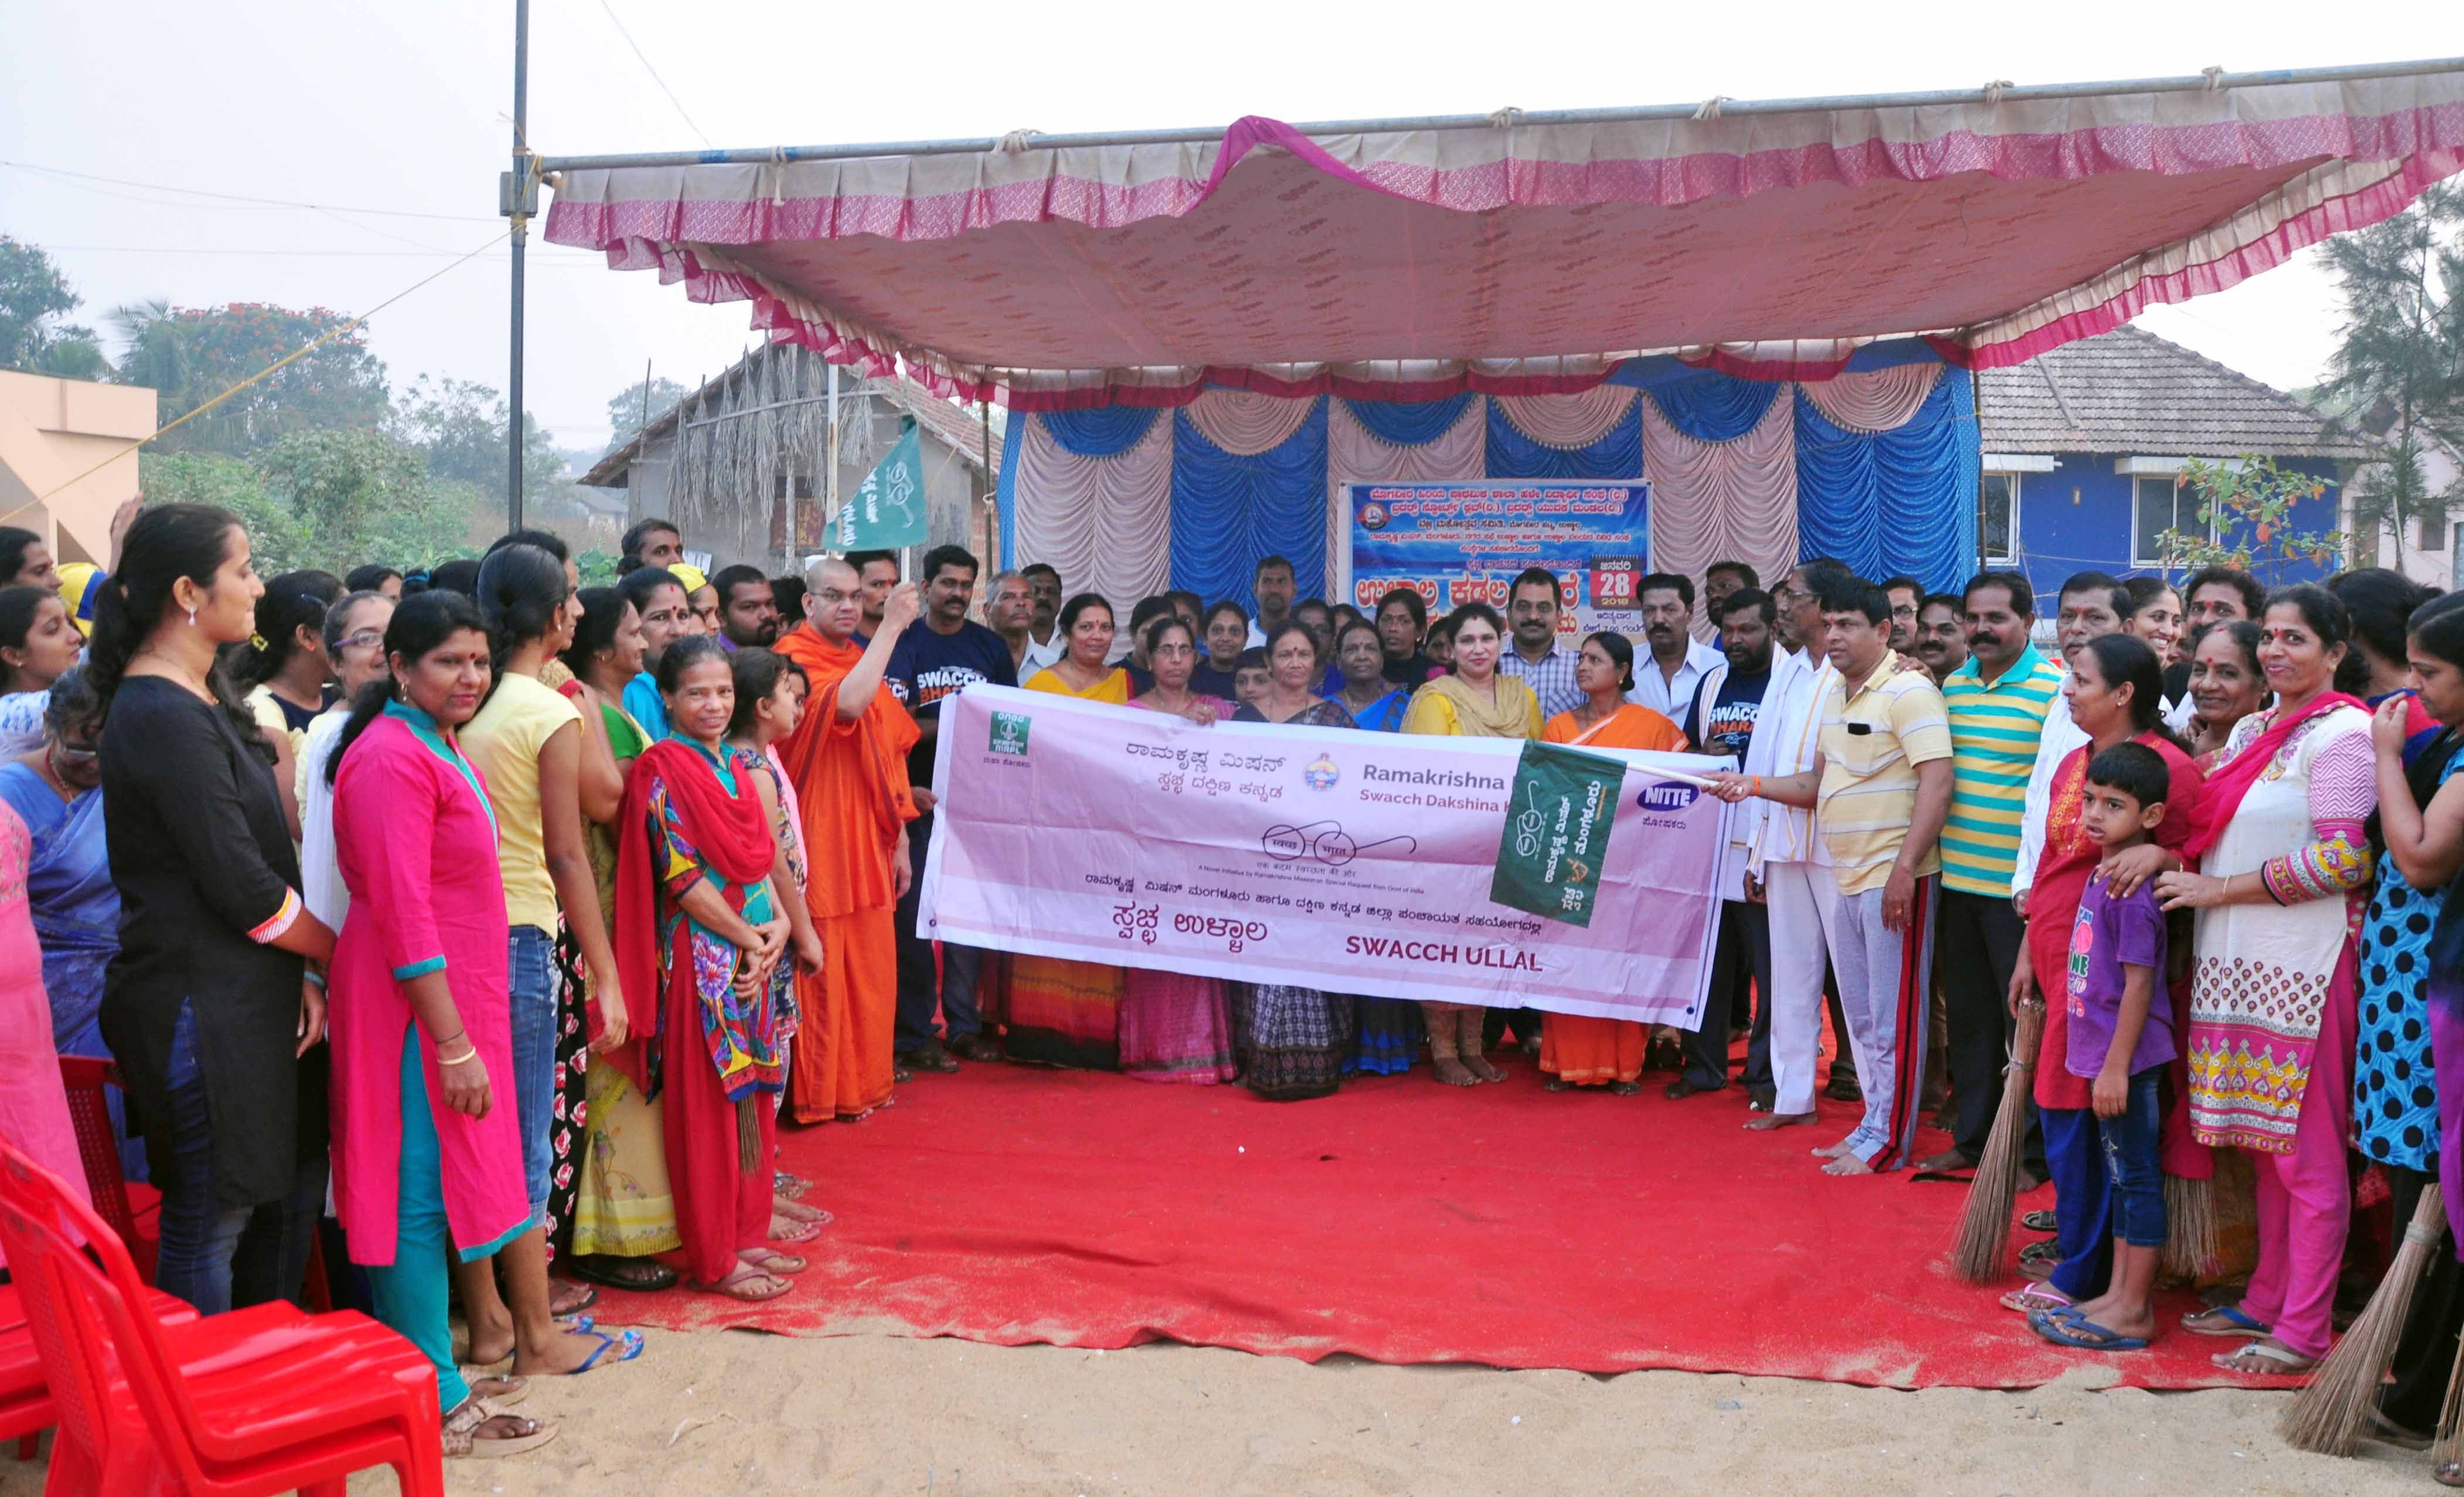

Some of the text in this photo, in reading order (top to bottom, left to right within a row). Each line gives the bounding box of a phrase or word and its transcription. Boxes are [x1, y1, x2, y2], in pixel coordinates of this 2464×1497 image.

[1600, 560, 1631, 571] ಜನವರಿ
[1600, 572, 1630, 596] 28
[1126, 742, 1287, 773] ರಾಮಕೃಷ್ಣ ಮಿಷನ್
[1192, 775, 1231, 797] ದಕ್ಷಿಣ
[1239, 782, 1283, 802] ಕನ್ನಡ
[1363, 764, 1505, 790] Ramakrishna
[1359, 789, 1422, 806] Swacch
[1426, 794, 1500, 813] Dakshina
[1644, 787, 1691, 806] NITTE
[1574, 781, 1600, 855] ಮಂಗಳೂರು
[1322, 845, 1346, 855] भारत
[1085, 873, 1134, 893] ರಾಮಕೃಷ್ಣ
[1144, 879, 1182, 894] ಮಿಷನ್
[1188, 884, 1250, 902] ಮಂಗಳೂರು
[1255, 894, 1290, 907] ಹಾಗೂ
[1296, 897, 1325, 914] ದಕ್ಷಿಣ
[1330, 900, 1361, 919] ಕನ್ನಡ
[1366, 906, 1393, 921] ಜಿಲ್ಲಾ
[1174, 913, 1267, 953] ಉಳ್ಳಾಲ
[1346, 935, 1543, 972] SWACCH ULLAL
